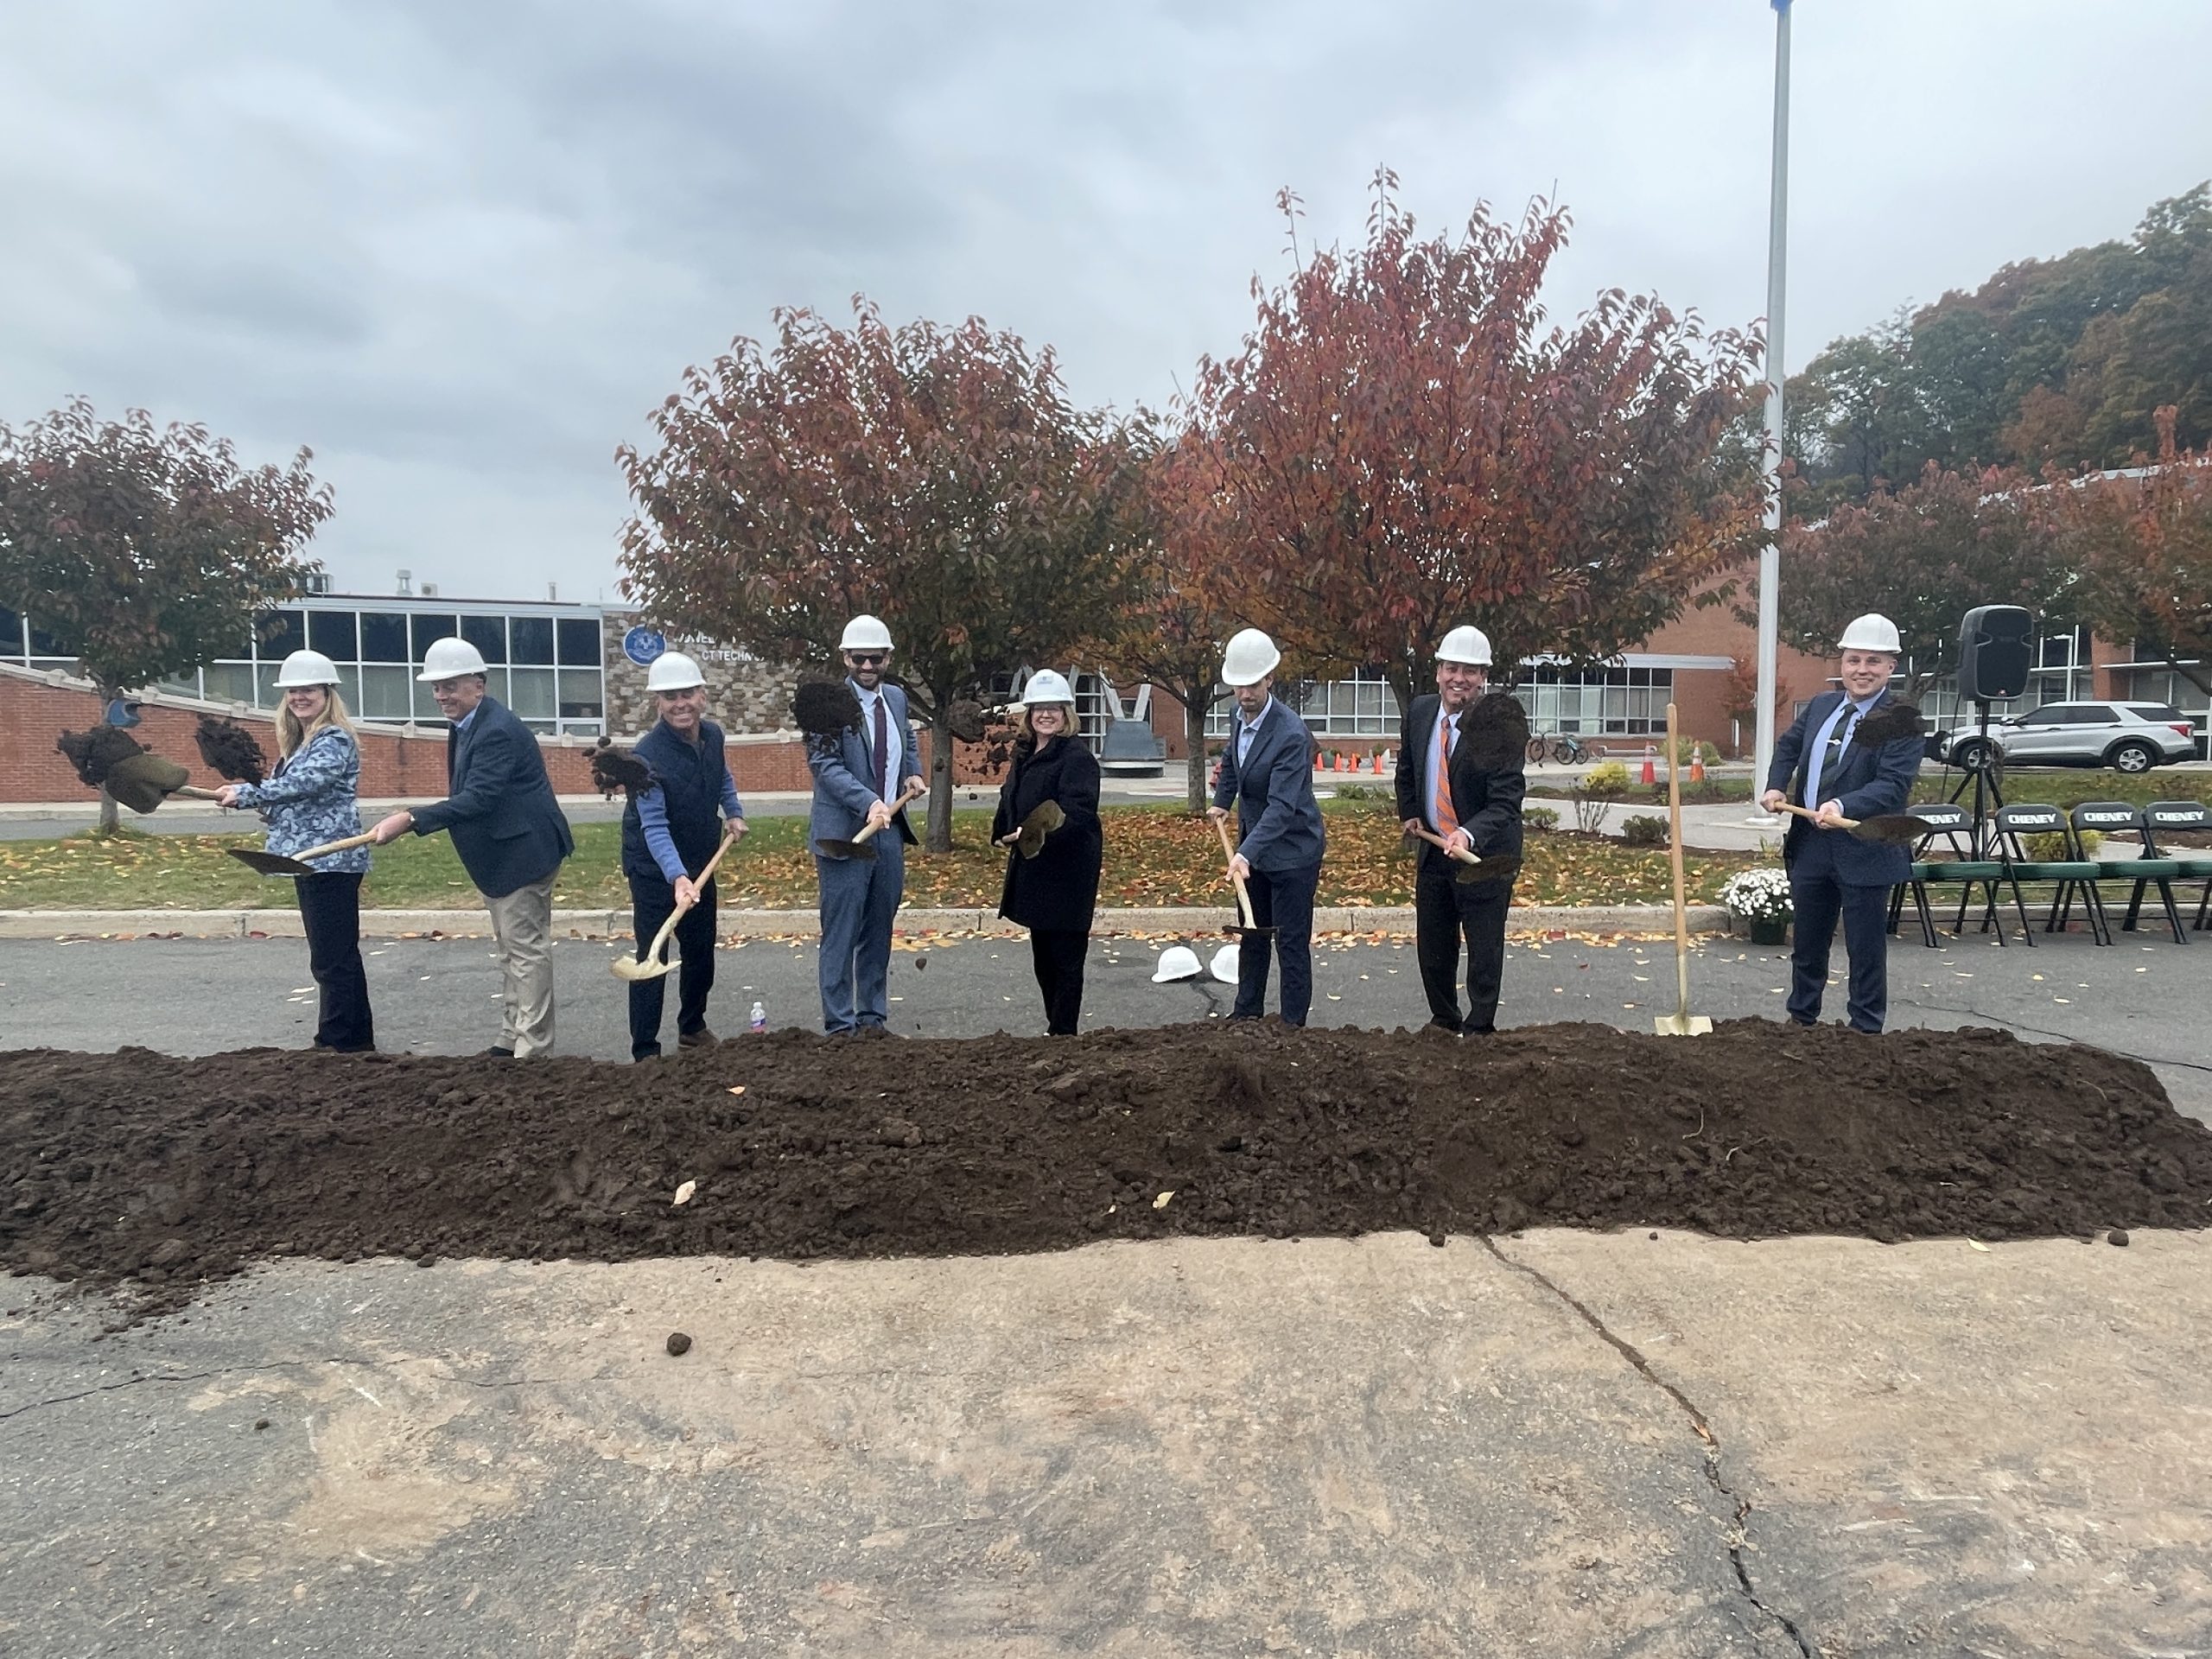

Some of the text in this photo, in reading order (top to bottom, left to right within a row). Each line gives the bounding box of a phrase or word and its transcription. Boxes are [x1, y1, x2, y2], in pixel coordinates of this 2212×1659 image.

[702, 651, 765, 661] CT TECHN
[1916, 813, 1961, 824] HENEY
[2007, 813, 2056, 824] CHENEY
[2083, 811, 2133, 822] CHENEY
[2155, 810, 2204, 822] CHENEY
